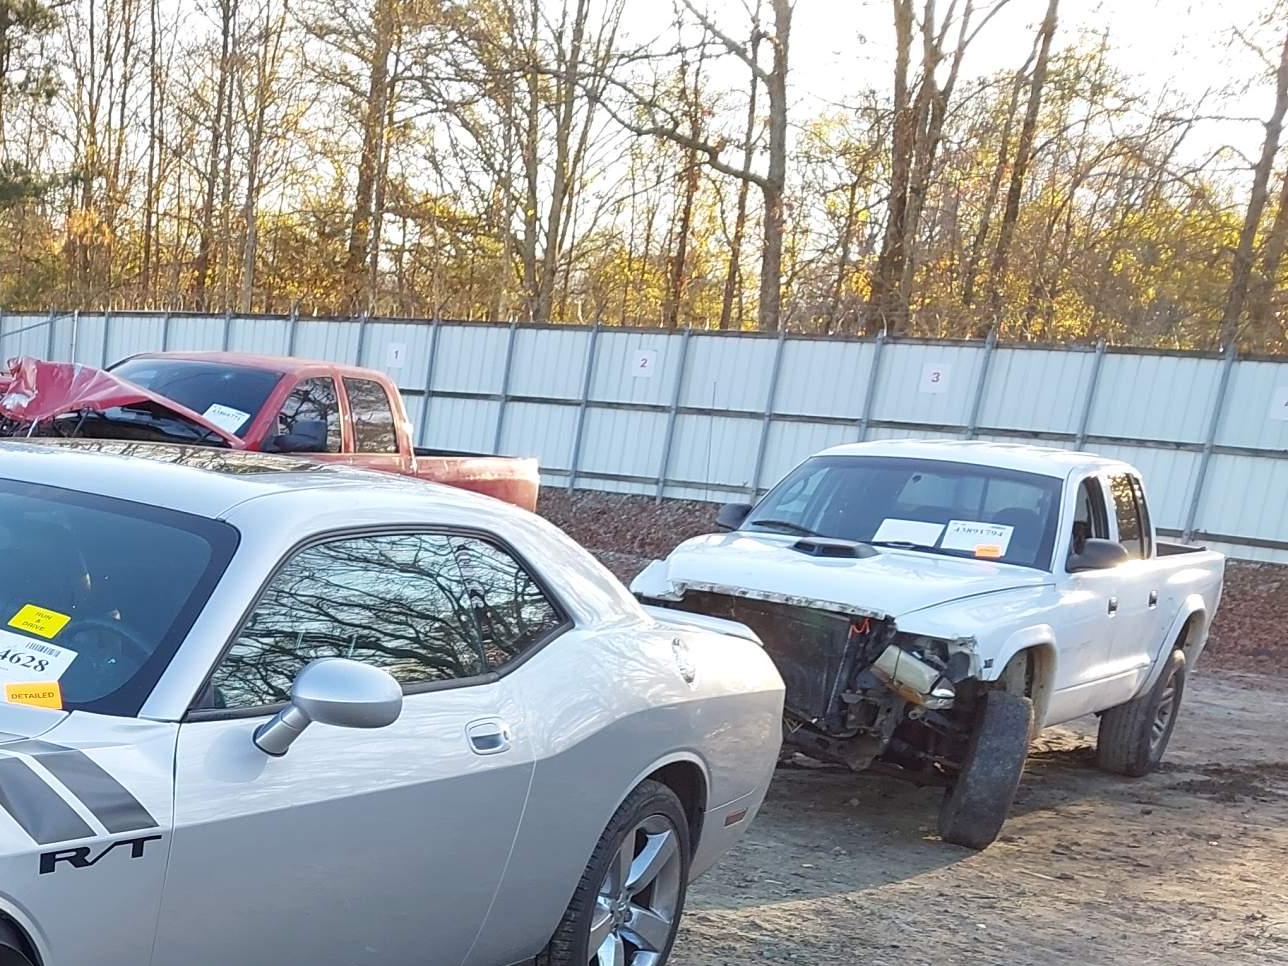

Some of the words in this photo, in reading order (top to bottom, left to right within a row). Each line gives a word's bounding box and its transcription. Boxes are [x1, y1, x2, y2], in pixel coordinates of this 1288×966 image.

[640, 358, 649, 368] 2
[931, 372, 941, 383] 3
[34, 611, 53, 621] RUN
[22, 621, 45, 631] DRIVE
[11, 691, 55, 701] DETAILED
[39, 834, 162, 875] R/T
